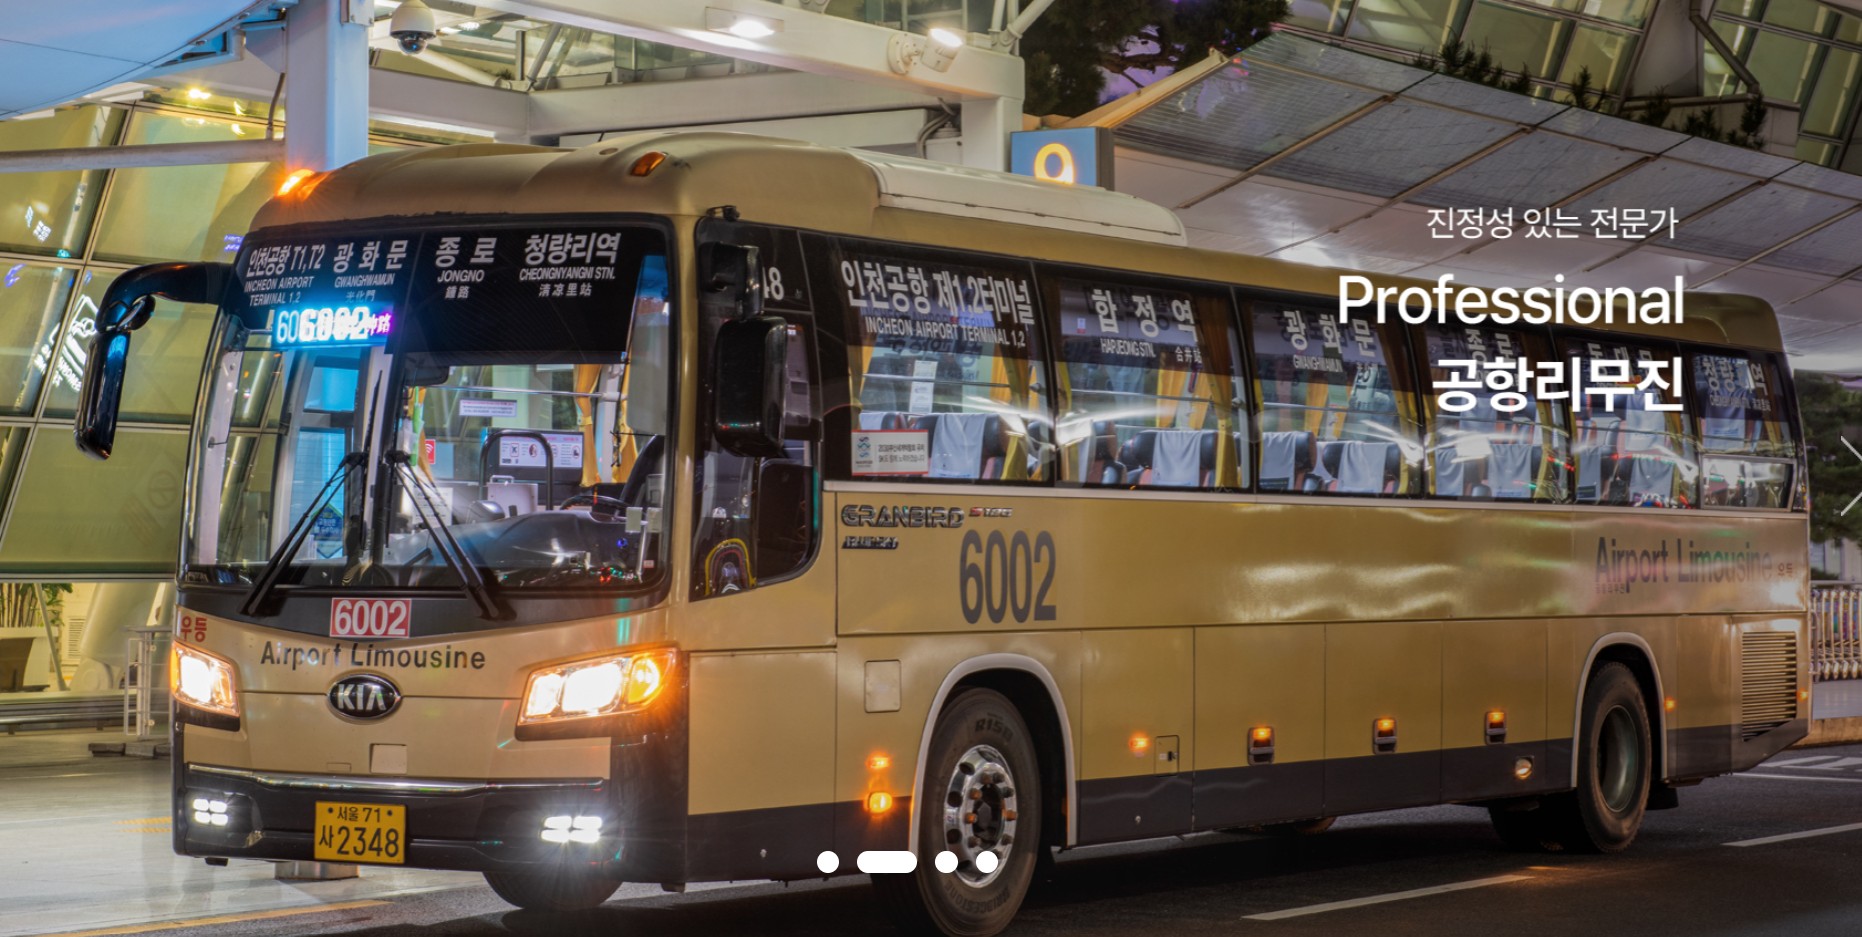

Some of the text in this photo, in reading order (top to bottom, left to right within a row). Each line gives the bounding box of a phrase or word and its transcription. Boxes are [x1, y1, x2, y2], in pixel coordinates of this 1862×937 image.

[246, 245, 291, 277] 인천공항
[333, 240, 408, 273] 광화문
[435, 236, 497, 267] 종로
[524, 232, 621, 266] 청량리역
[244, 276, 314, 293] INCHEON AIRPORT
[334, 273, 395, 288] GWANGHWAMUN
[437, 269, 485, 283] JONGNO
[519, 267, 616, 281] CHEONGNYANGNI STN.
[841, 260, 931, 315] 인천공항
[249, 293, 286, 307] TERMINAL
[1091, 289, 1198, 342] 합정역
[865, 316, 912, 337] INCHEON
[916, 322, 960, 340] AIRPORT
[962, 325, 1010, 346] TERMINAL
[1283, 310, 1376, 357] 광화문
[1100, 338, 1139, 357] HAPJEONG
[841, 504, 965, 528] GRANBIRD
[959, 529, 1057, 625] 6002
[1596, 536, 1773, 593] Airport Limousine
[181, 615, 208, 643] 우등
[333, 600, 407, 636] 6002
[260, 640, 487, 671] Airport Limousine
[337, 683, 388, 711] KIA
[337, 806, 381, 823] 서울 71
[319, 825, 399, 858] 사 2348
